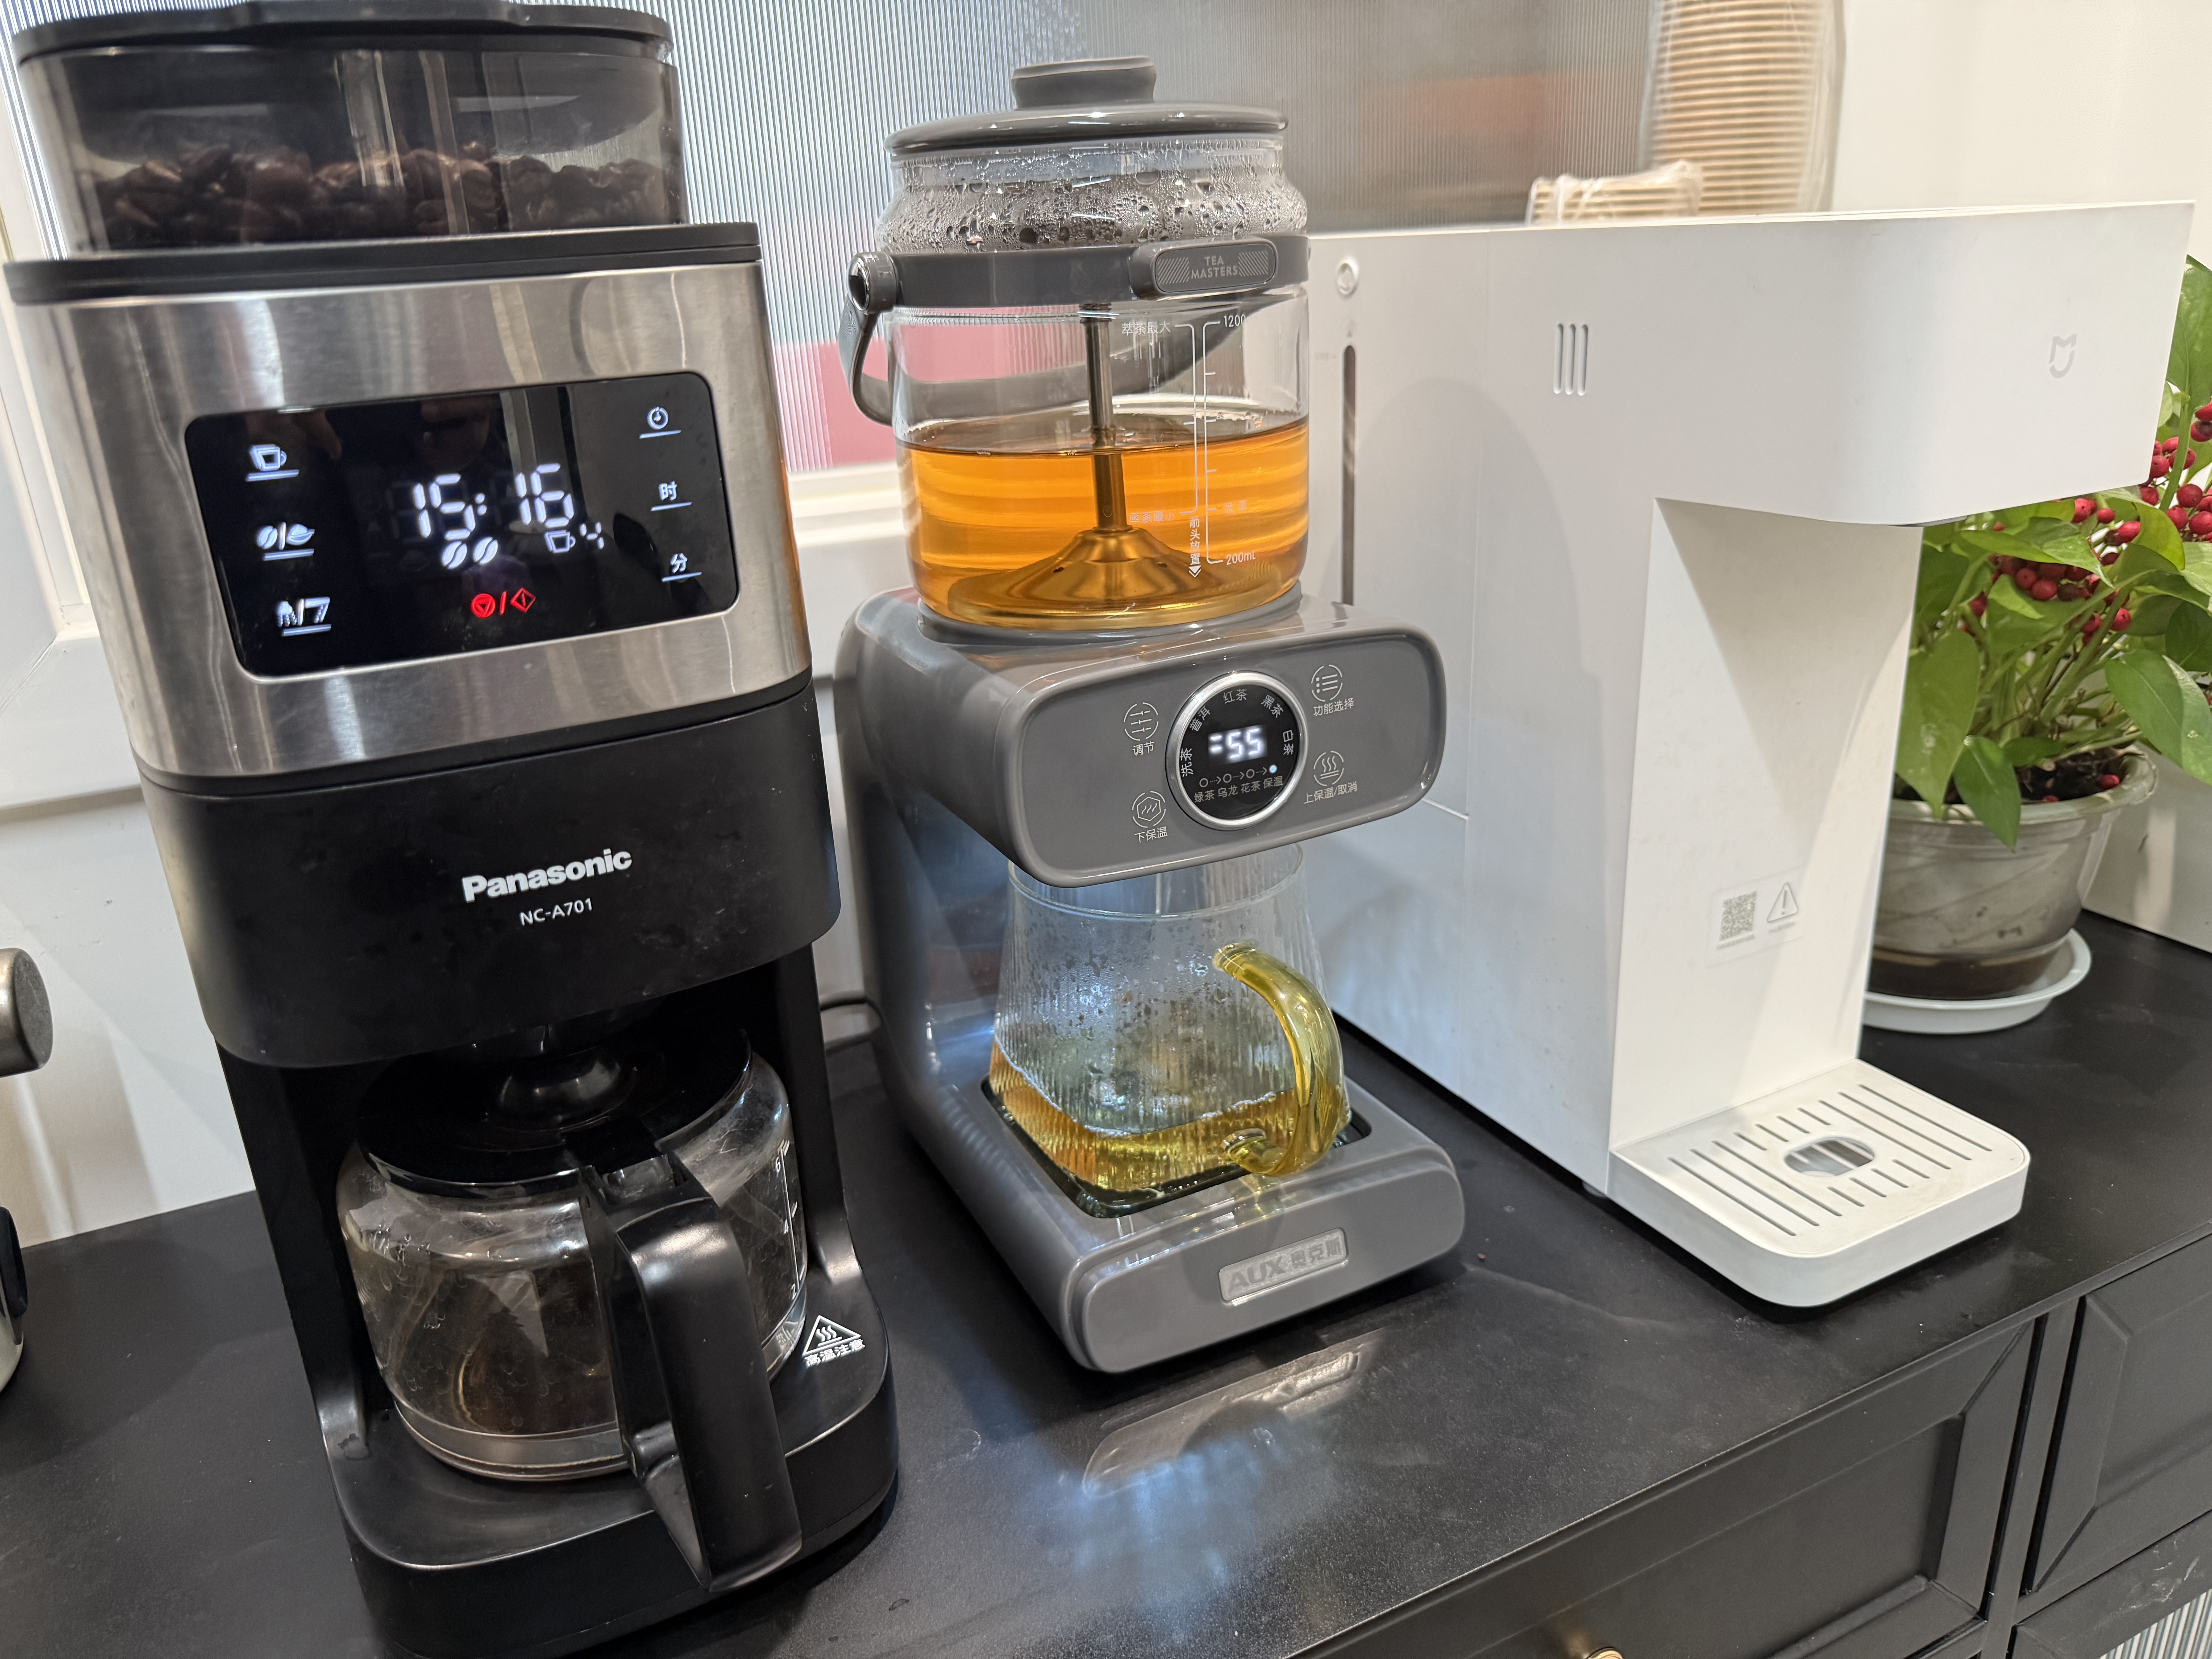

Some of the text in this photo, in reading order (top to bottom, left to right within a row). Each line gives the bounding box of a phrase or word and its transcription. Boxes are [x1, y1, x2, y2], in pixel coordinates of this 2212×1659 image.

[1191, 265, 1238, 279] MASTERS
[1204, 256, 1224, 266] TEA
[1121, 320, 1171, 336] 萃茶最大
[413, 463, 574, 541] 15:16
[659, 481, 677, 500] 时
[580, 522, 604, 550] 4
[1190, 515, 1201, 565] 箭头放置
[670, 553, 688, 573] 分
[1226, 551, 1256, 565] 200mL
[1223, 689, 1247, 704] 红茶
[1261, 694, 1284, 718] 黑茶
[1313, 697, 1354, 716] 功能选择
[1189, 705, 1211, 732] 普洱
[1132, 741, 1154, 756] 调节
[1283, 730, 1294, 755] 白茶
[1180, 747, 1194, 777] 洗茶
[1194, 775, 1283, 803] 绿茶 乌龙 花茶 保温
[1304, 781, 1357, 804] 上保温/取消
[1134, 826, 1168, 843] 下保温
[462, 848, 632, 903] Panasonic
[519, 897, 592, 926] NC-A701
[776, 1156, 781, 1173] 6
[1229, 1255, 1286, 1292] AUX
[803, 1338, 866, 1368] 高温注意
